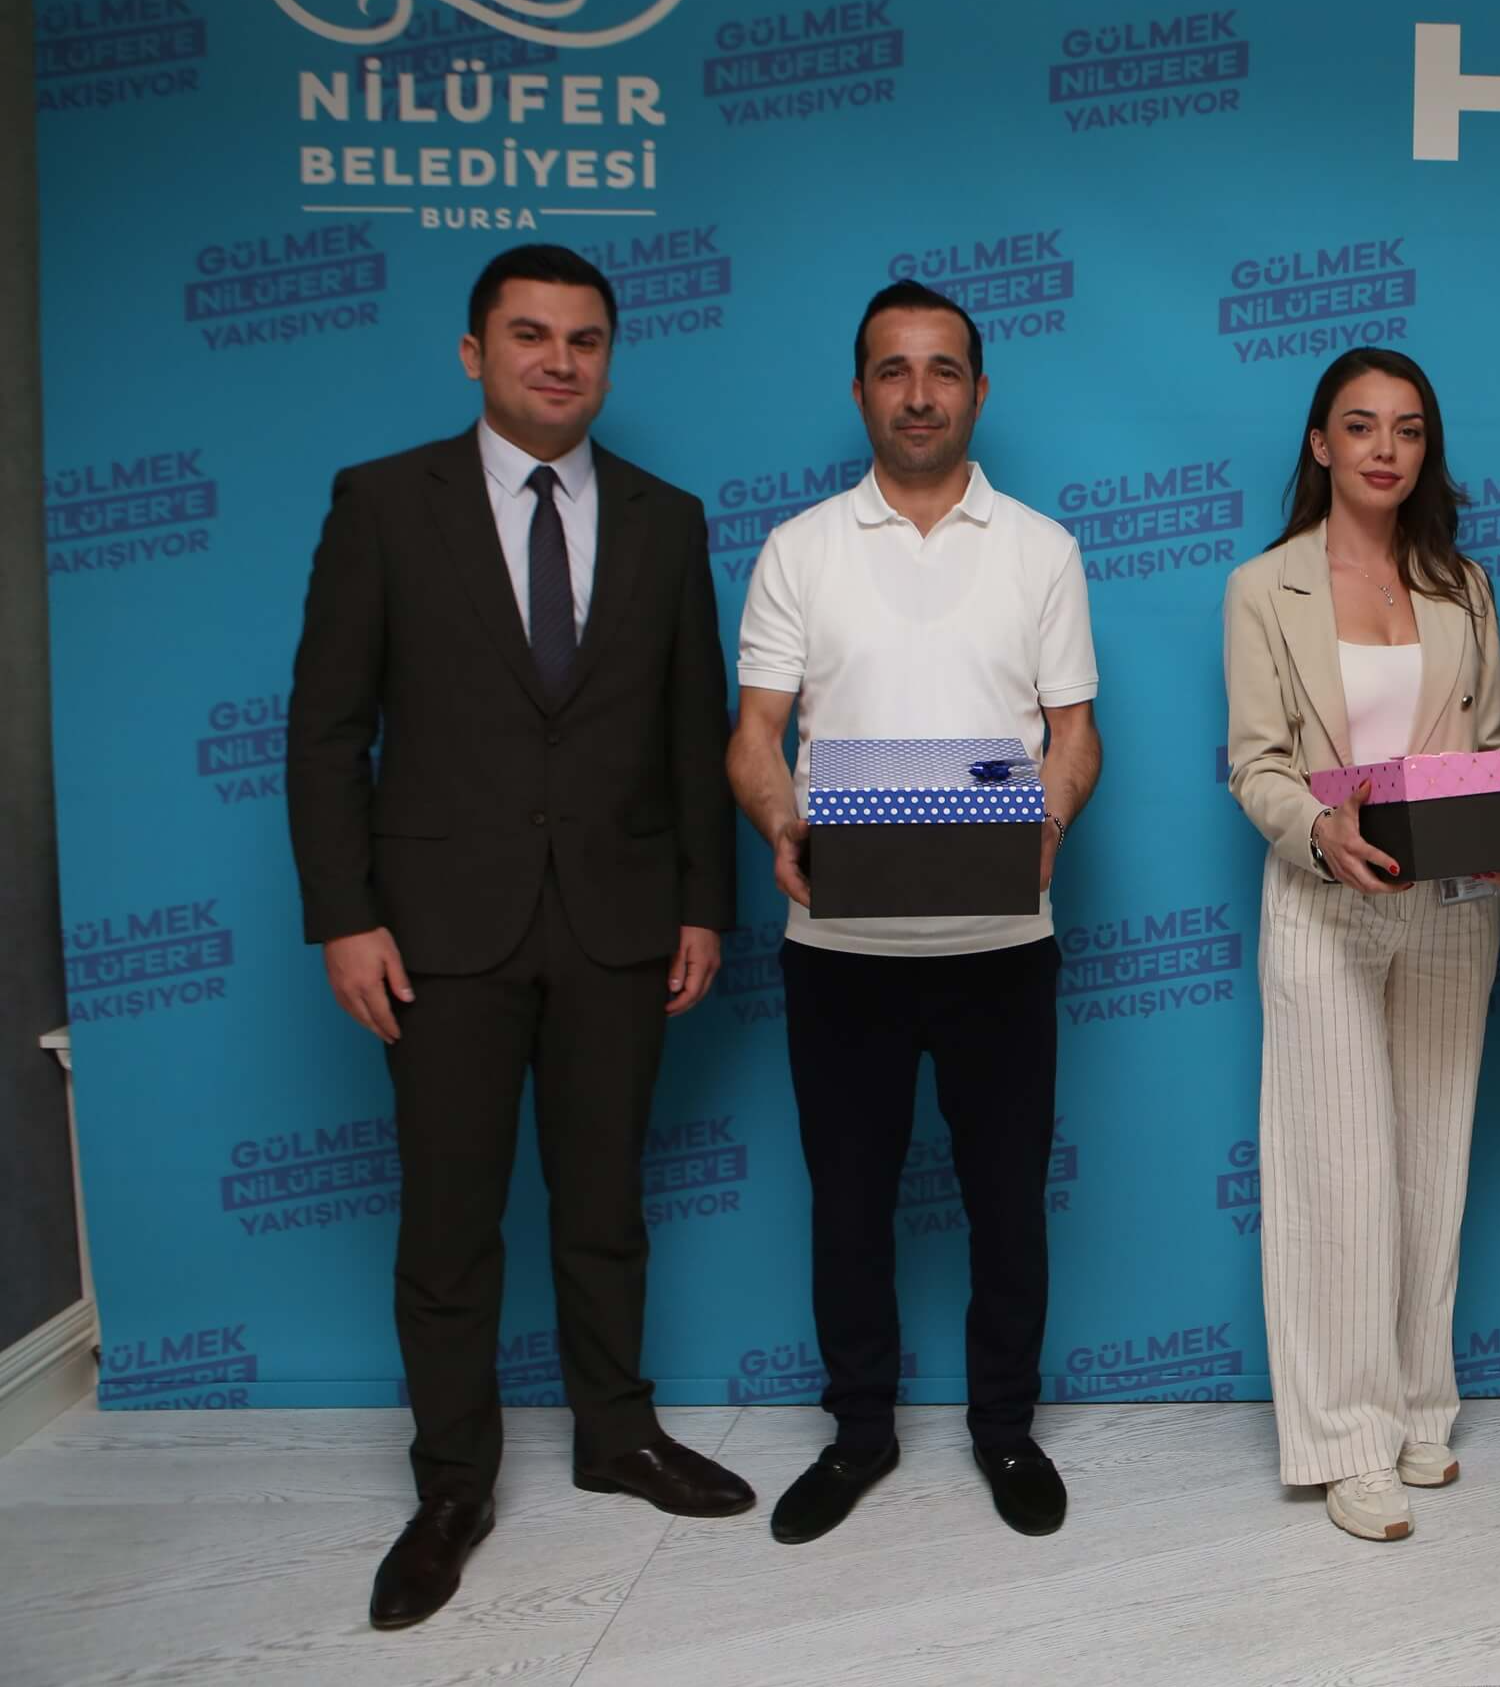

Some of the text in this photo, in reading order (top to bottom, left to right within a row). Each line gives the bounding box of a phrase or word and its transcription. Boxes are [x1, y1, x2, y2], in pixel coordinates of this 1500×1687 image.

[714, 0, 892, 53] GÜLMEK
[1062, 9, 1237, 58] GÜLMEK
[299, 58, 667, 126] NİLÜFER
[1064, 88, 1240, 133] YAKIŞIYOR
[300, 138, 657, 190] BELEDİYESİ
[420, 207, 538, 230] BURSA
[195, 220, 375, 275] GÜLMEK
[888, 229, 1062, 281] GÜLMEK
[1231, 238, 1405, 290] GÜLMEK
[202, 302, 379, 350] YAKIŞIYOR
[1233, 317, 1407, 364] YAKIŞIYOR
[54, 449, 204, 497] ÜLMEK
[1058, 457, 1232, 512] GÜLMEK
[49, 529, 209, 573] AKIŞIYOR
[1086, 538, 1235, 582] AKIŞIYOR
[73, 898, 219, 949] ÜLMEK
[1061, 903, 1230, 953] GÜLMEK
[71, 977, 226, 1023] AKIŞIYOR
[1065, 979, 1234, 1025] YAKIŞIYOR
[103, 1323, 247, 1373] ÜLMEK
[1066, 1322, 1232, 1376] GÜLMEK
